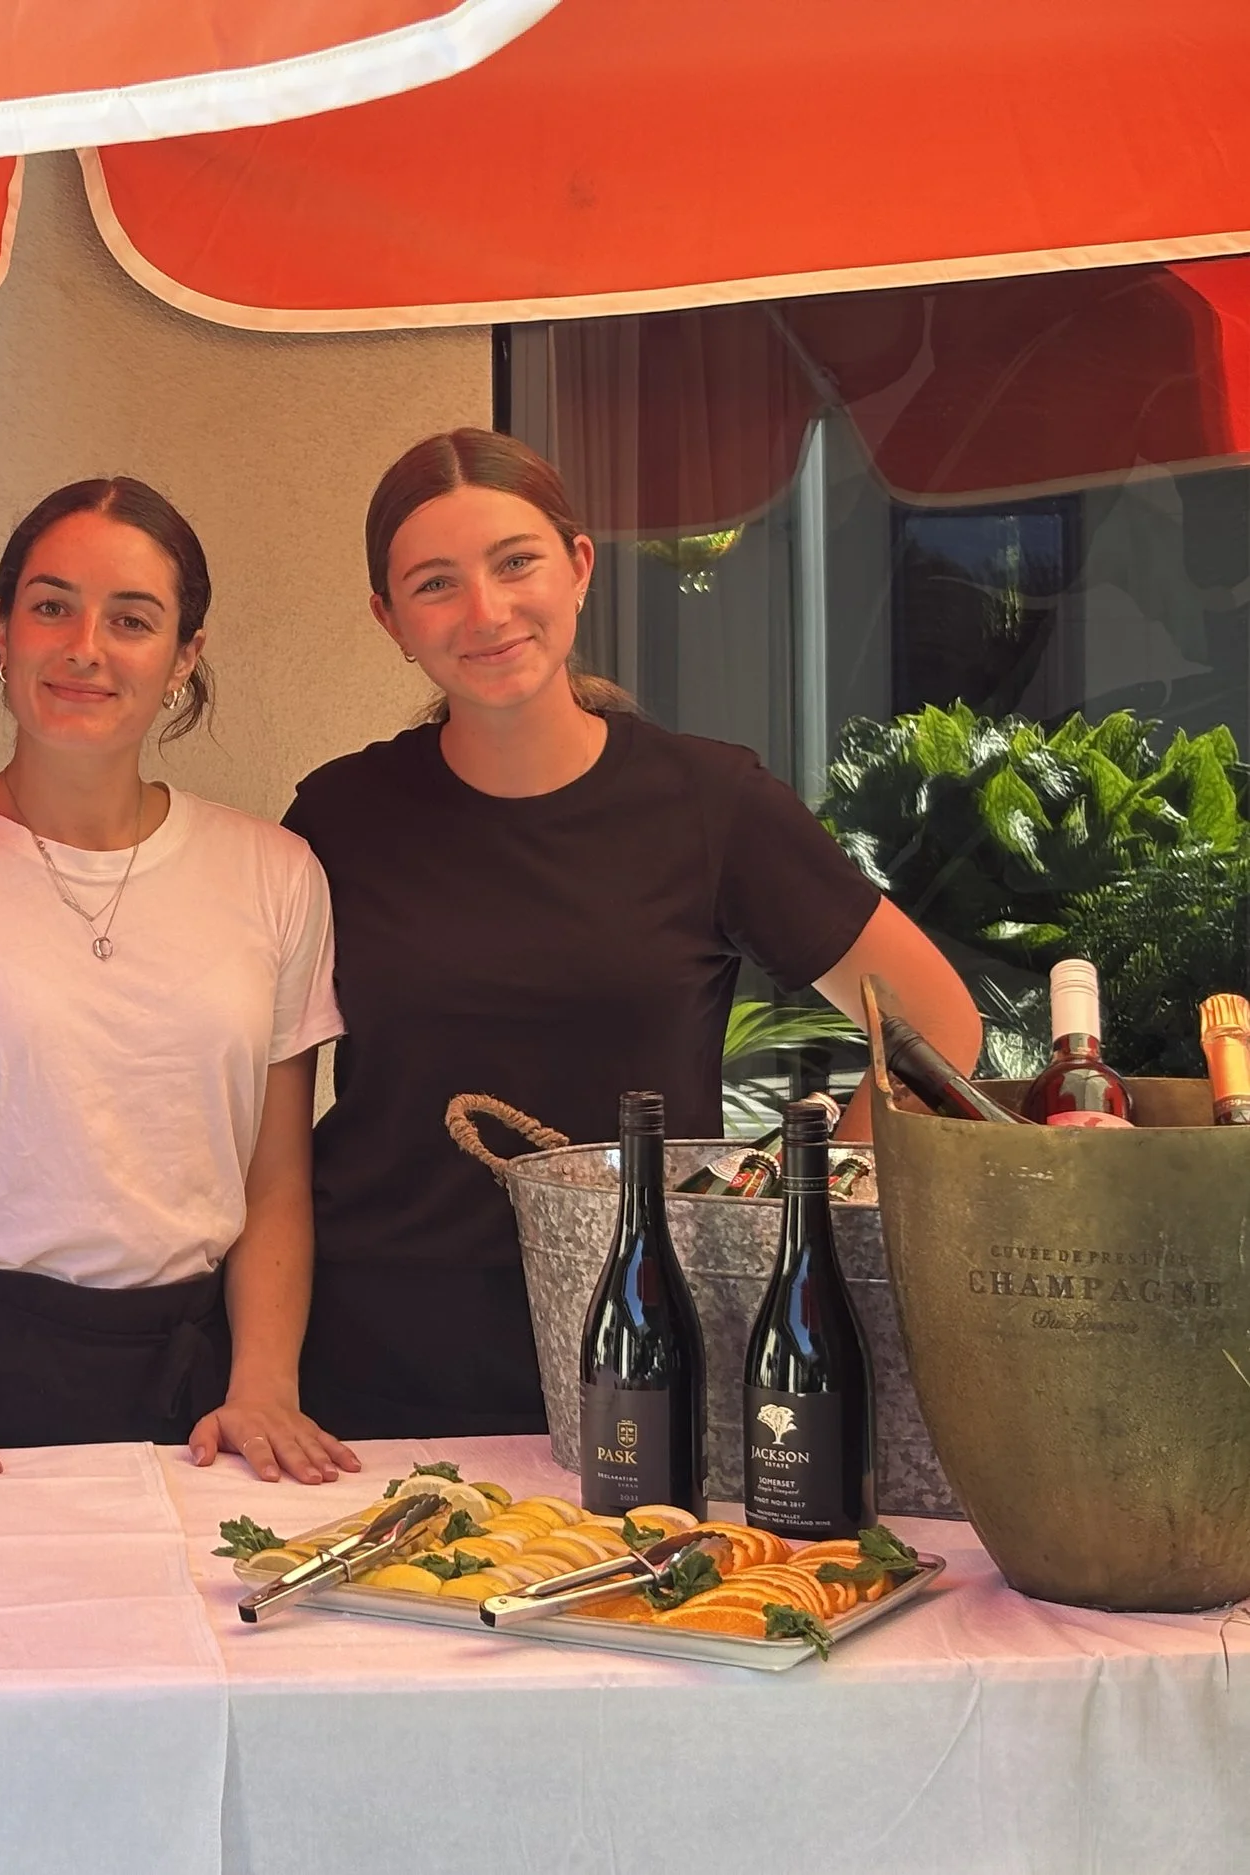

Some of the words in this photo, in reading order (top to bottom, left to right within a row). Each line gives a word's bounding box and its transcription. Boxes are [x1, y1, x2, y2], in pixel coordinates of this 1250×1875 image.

[1058, 1249, 1083, 1264] DE
[968, 1269, 1223, 1308] CHAMPAGNE
[597, 1446, 638, 1464] PASK
[751, 1445, 810, 1464] JACKSON
[765, 1461, 790, 1470] ESTATE
[758, 1476, 795, 1488] SOMERSET
[770, 1499, 788, 1507] NOIR
